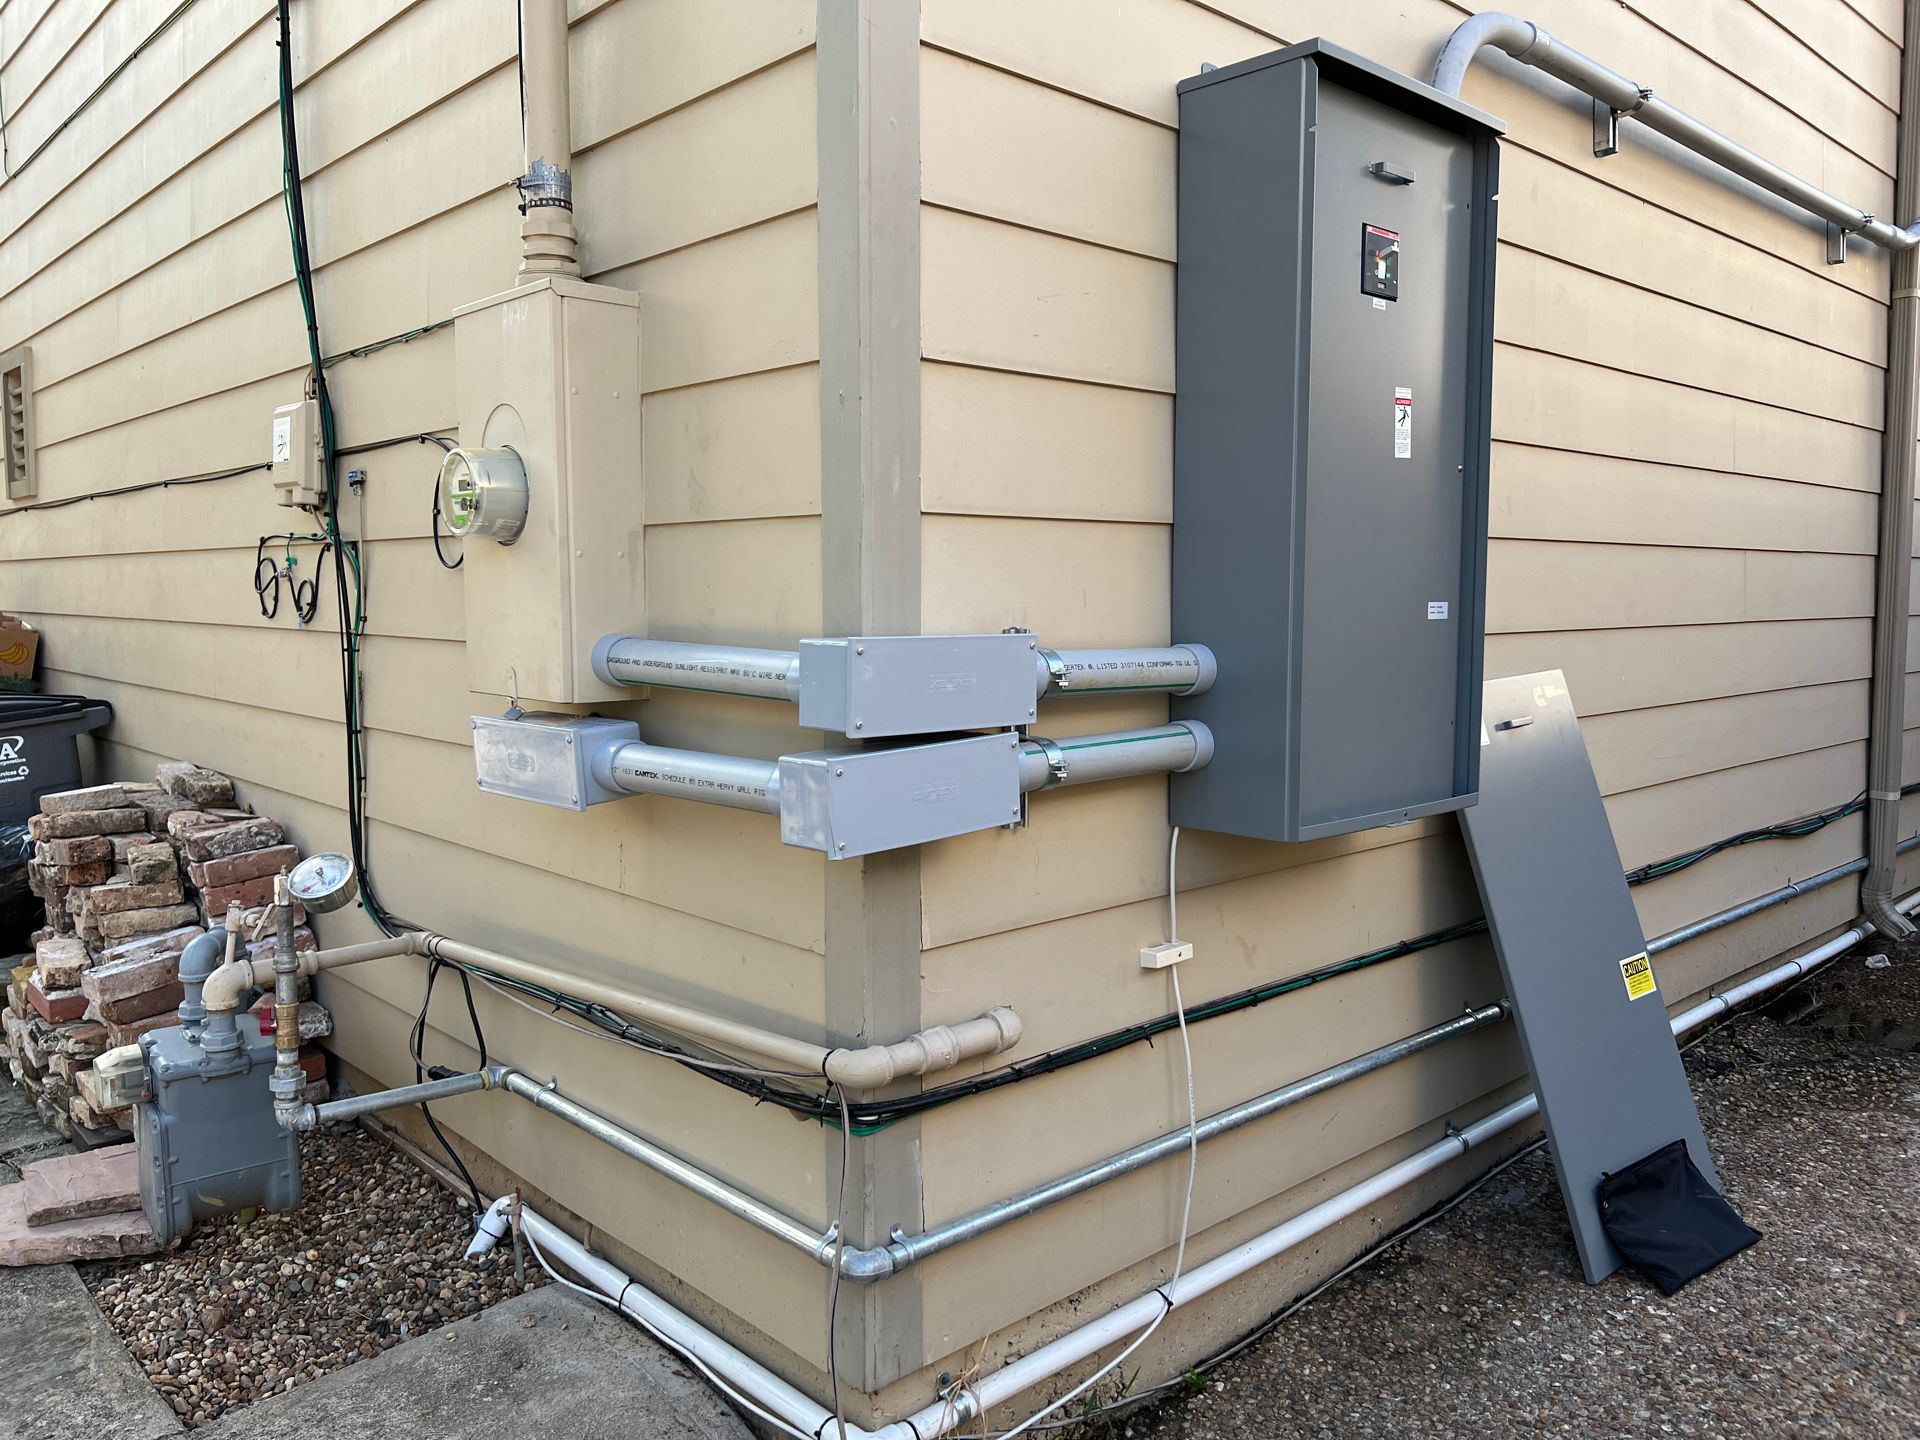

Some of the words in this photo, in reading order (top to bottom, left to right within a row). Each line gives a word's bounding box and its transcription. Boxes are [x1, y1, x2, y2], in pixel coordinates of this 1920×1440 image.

[643, 659, 673, 669] UNDERGROUND
[675, 663, 698, 672] SUNLIGHT
[700, 665, 728, 674] RESISTANT
[758, 671, 772, 679] WIRE
[634, 769, 658, 779] CANTEX
[661, 773, 686, 783] SCHEDULE
[698, 779, 715, 788] EXTRA
[717, 782, 734, 792] HEAVY
[737, 785, 751, 794] WALL
[1623, 958, 1649, 977] CAUTION
